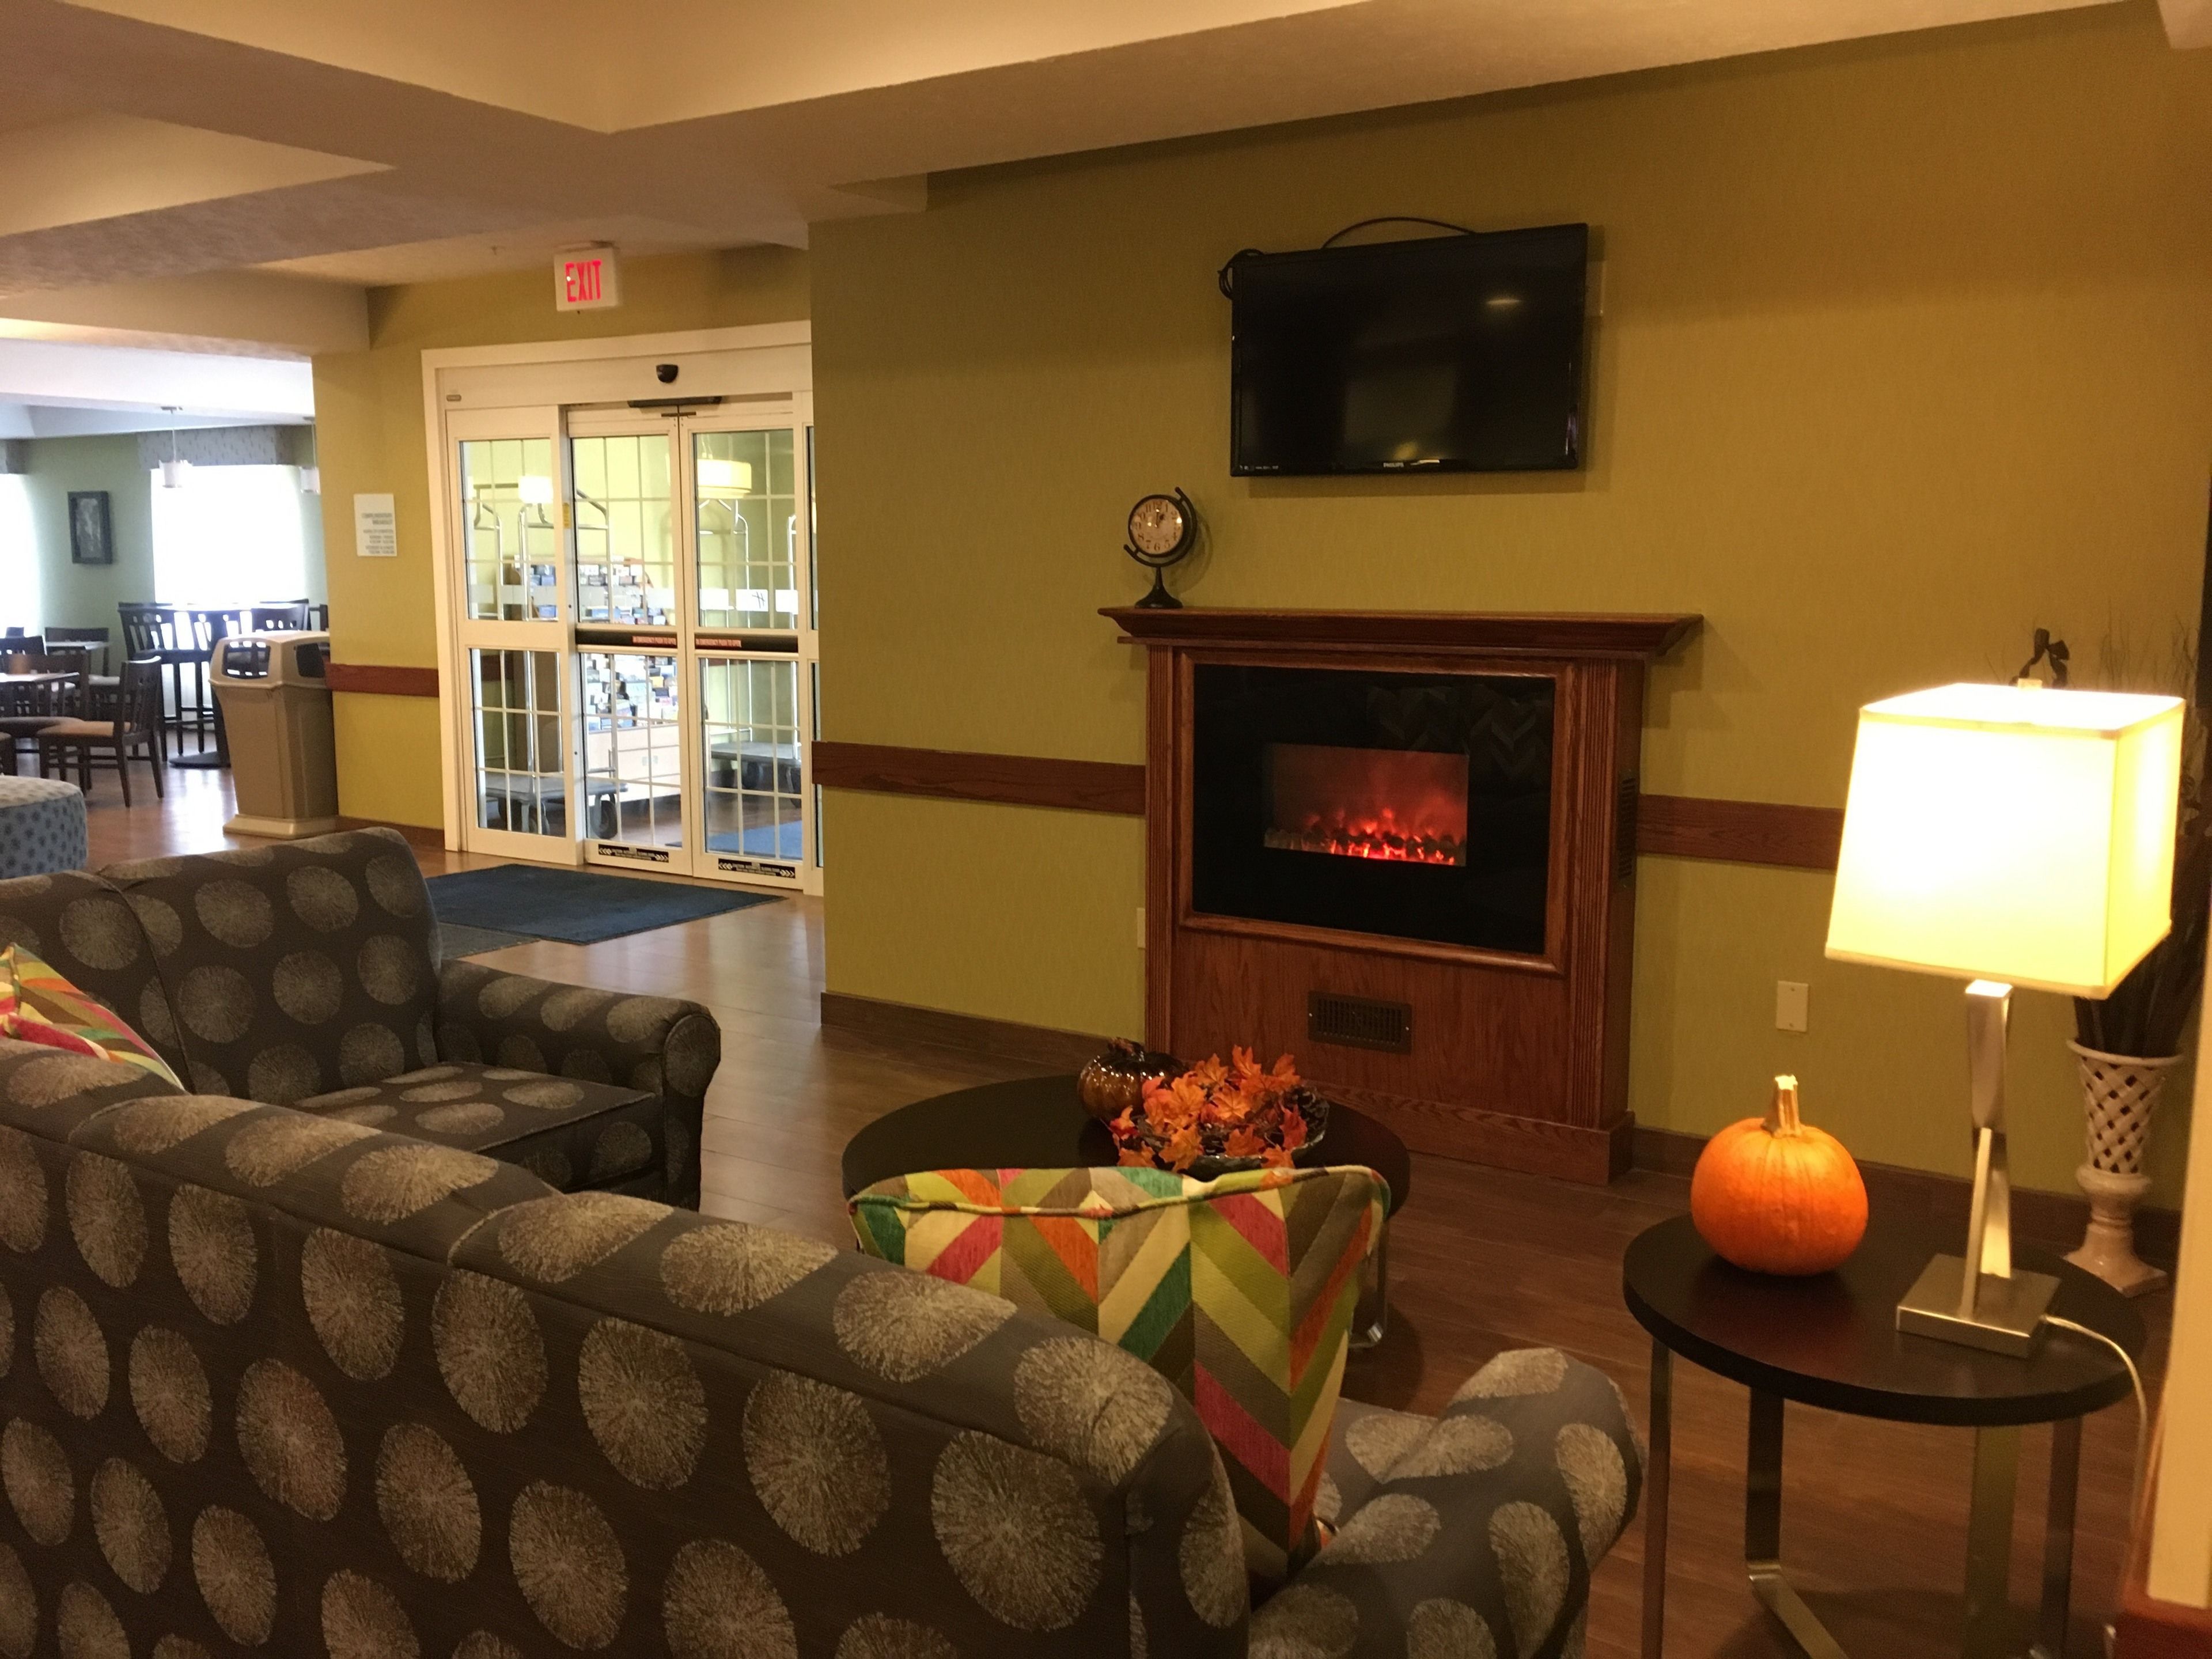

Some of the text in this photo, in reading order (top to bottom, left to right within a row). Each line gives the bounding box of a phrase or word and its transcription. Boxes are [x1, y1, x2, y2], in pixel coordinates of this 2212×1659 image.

[565, 259, 602, 302] EXIT
[1145, 503, 1152, 513] 11
[1145, 539, 1152, 550] 7
[1154, 543, 1161, 551] 6
[1164, 539, 1171, 549] 5
